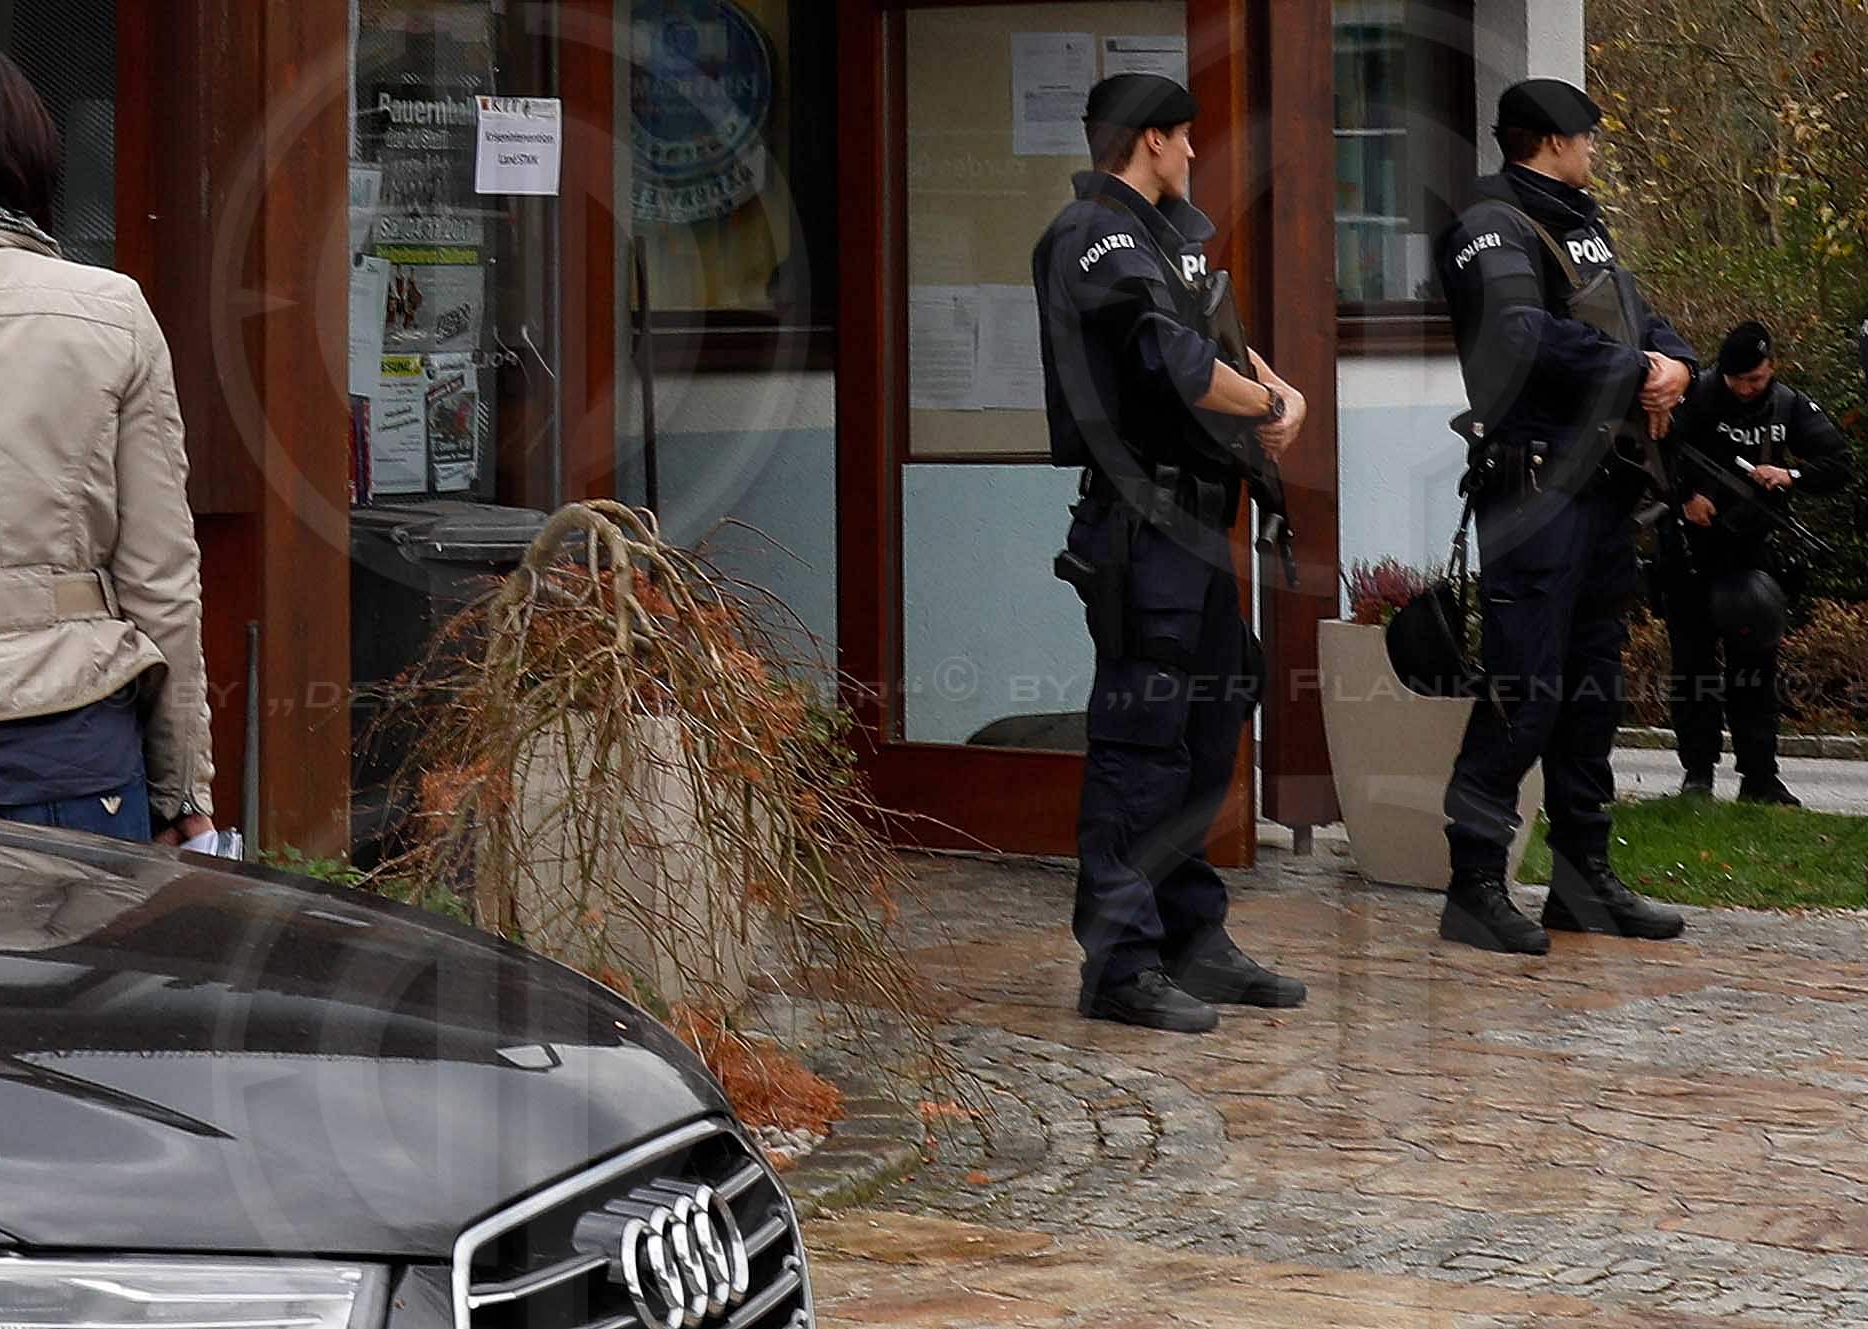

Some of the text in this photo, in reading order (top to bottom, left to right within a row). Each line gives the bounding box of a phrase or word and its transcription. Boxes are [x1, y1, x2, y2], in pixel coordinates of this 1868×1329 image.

[1079, 233, 1135, 272] POLIZEI
[1454, 232, 1502, 270] POLIZEI
[1566, 235, 1613, 265] POLI
